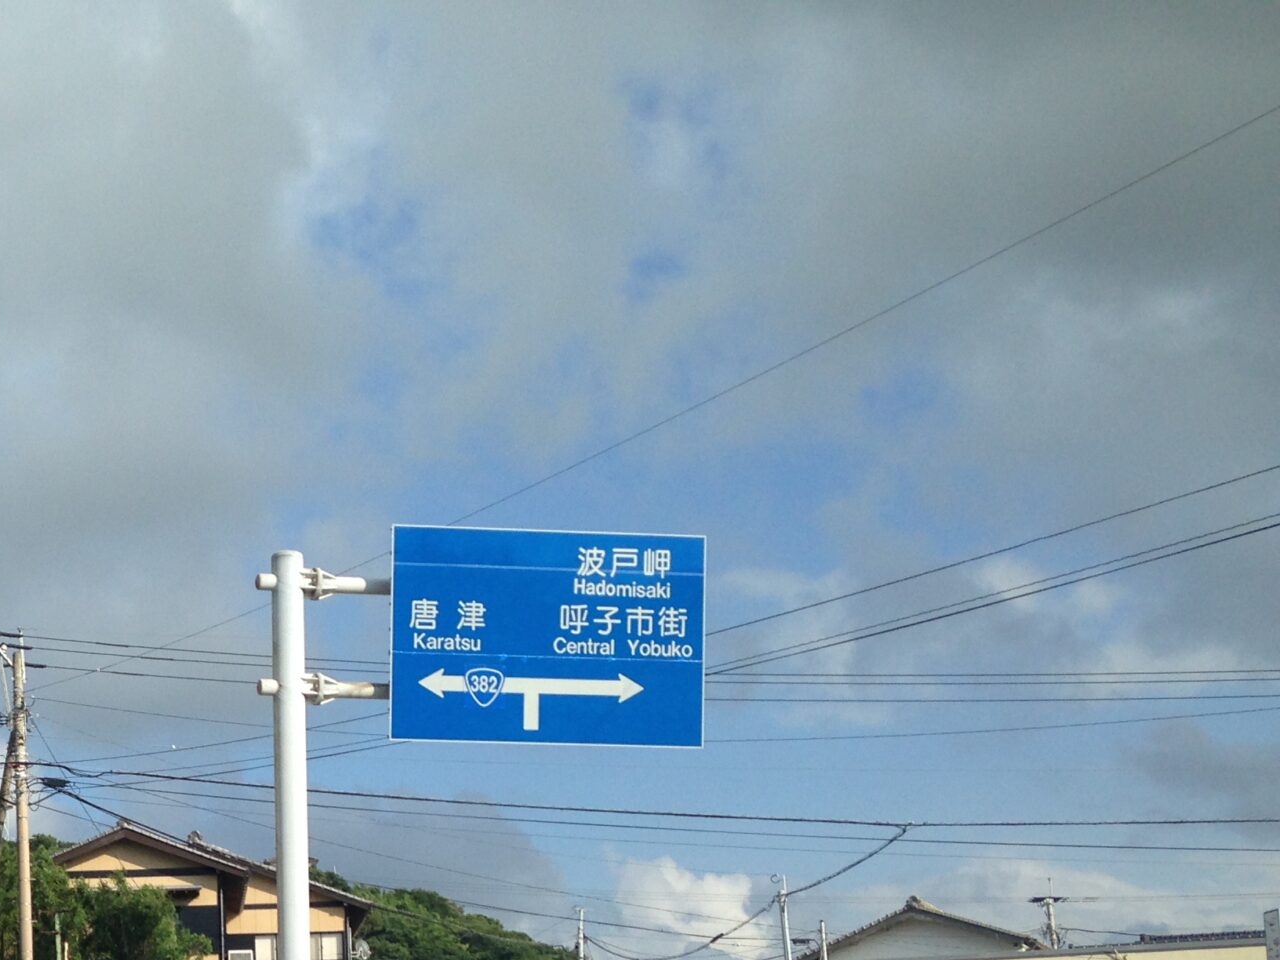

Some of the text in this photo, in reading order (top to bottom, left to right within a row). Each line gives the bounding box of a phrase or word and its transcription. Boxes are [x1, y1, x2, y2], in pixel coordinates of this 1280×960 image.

[577, 547, 671, 578] 波戸岬
[573, 578, 671, 599] Hadomisaki
[409, 598, 486, 631] 唐津
[560, 604, 688, 638] 呼子市街
[413, 633, 481, 651] Karatsu
[553, 637, 693, 658] Central Yobuko
[470, 674, 498, 693] 382
